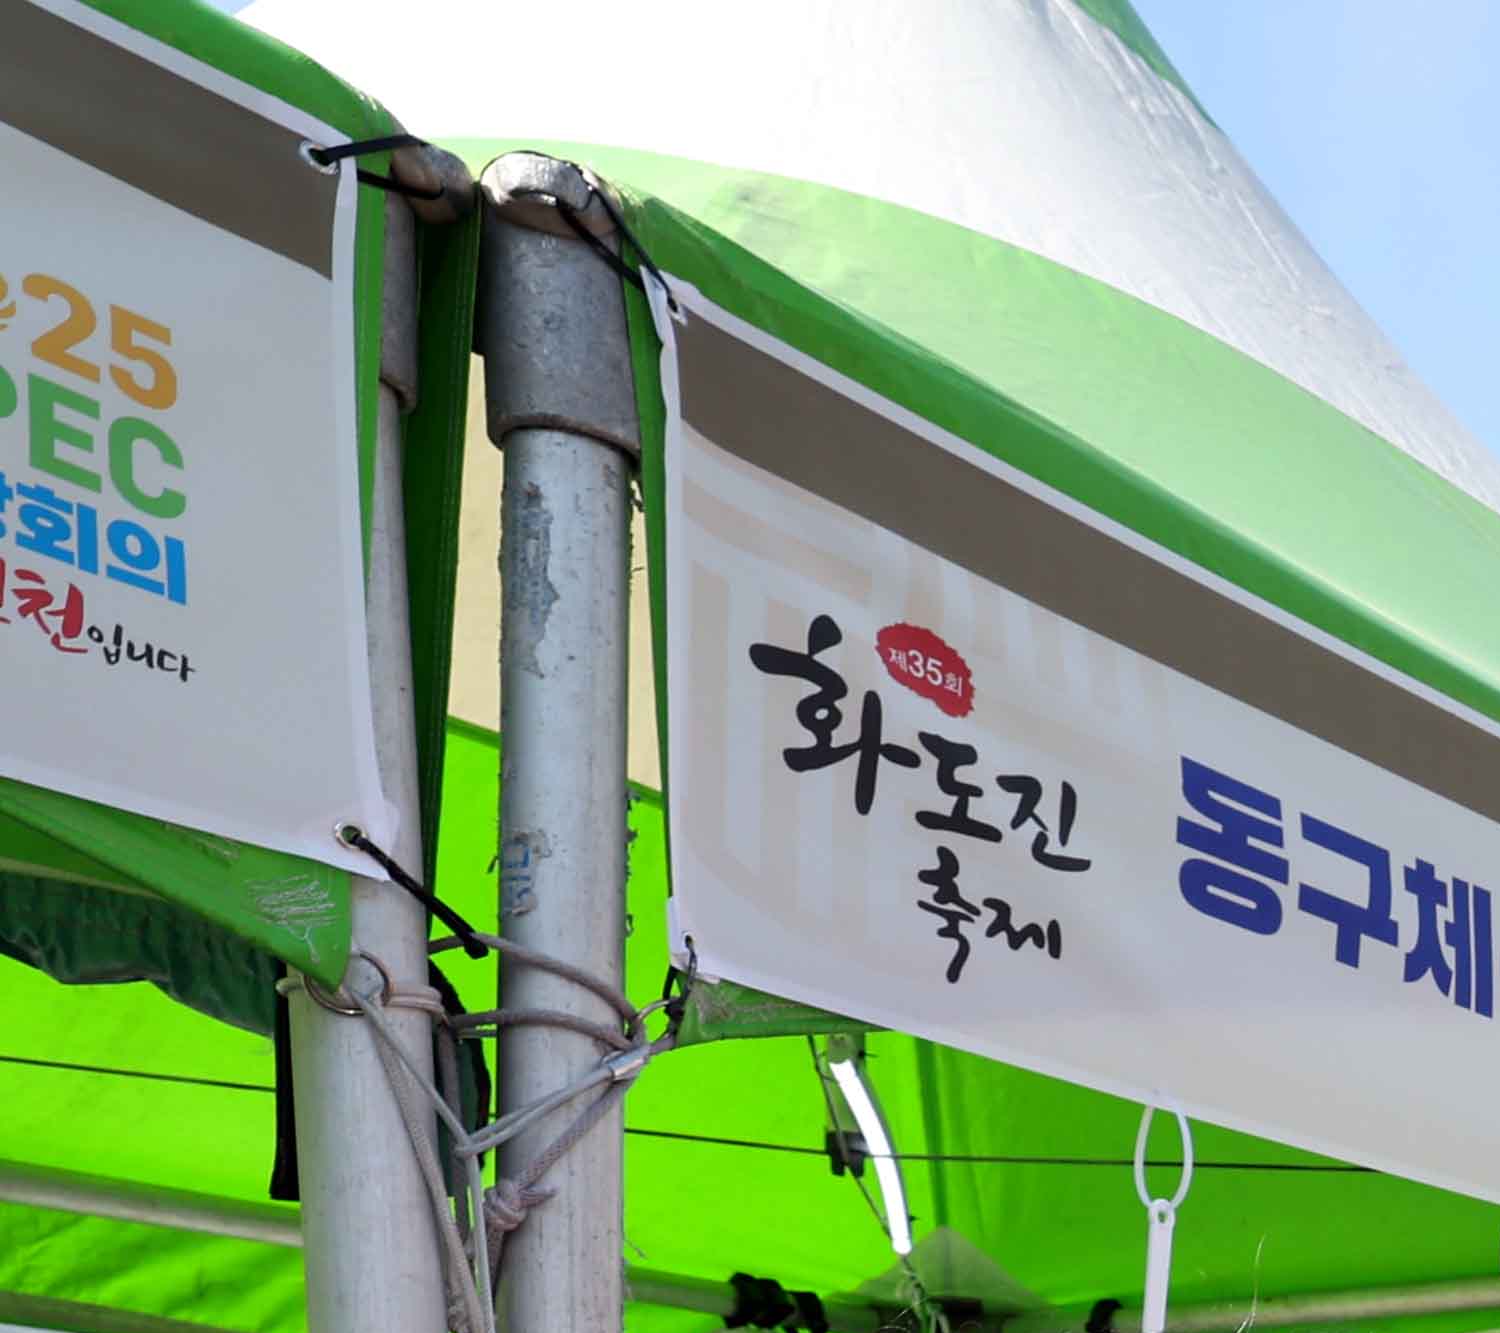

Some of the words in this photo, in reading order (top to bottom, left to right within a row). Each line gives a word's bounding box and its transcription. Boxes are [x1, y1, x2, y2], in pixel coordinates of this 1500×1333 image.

[889, 643, 964, 699] 제35회
[748, 613, 1092, 873] 화도진
[915, 846, 1063, 984] 축제
